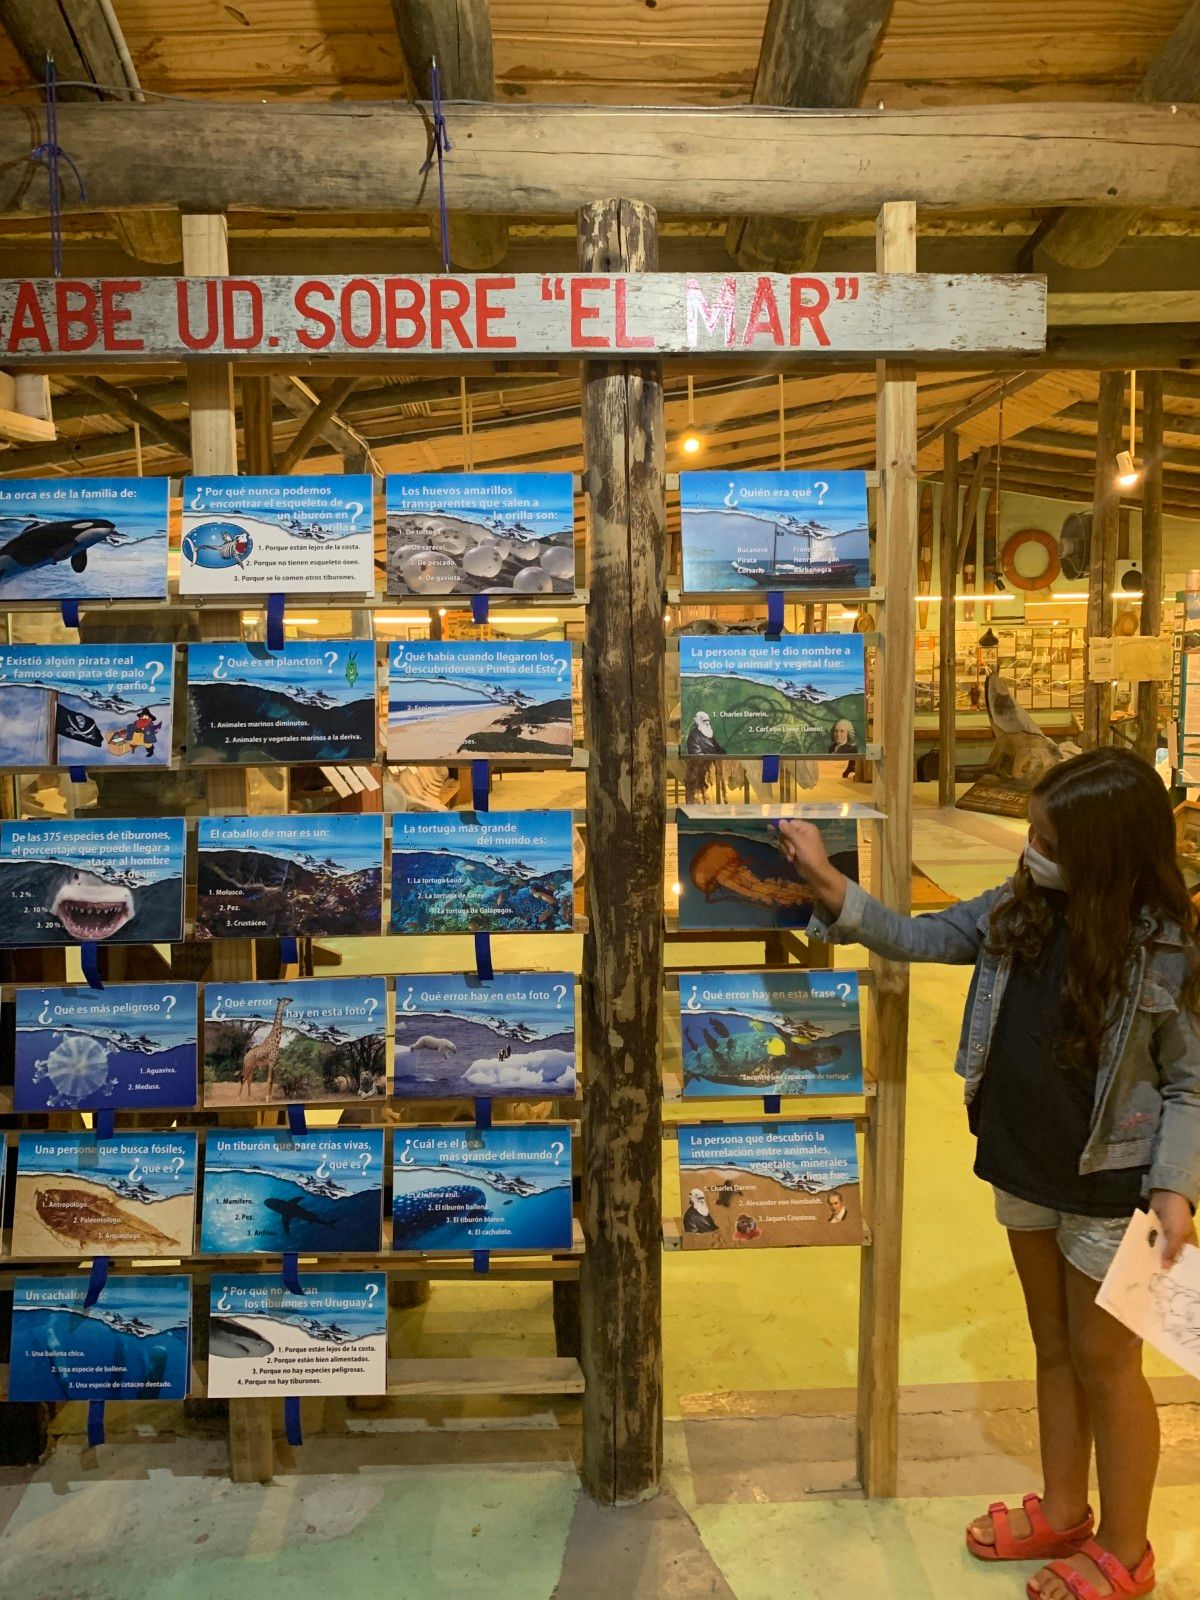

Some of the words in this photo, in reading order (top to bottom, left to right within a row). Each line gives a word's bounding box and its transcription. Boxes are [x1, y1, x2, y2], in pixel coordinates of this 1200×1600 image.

[176, 280, 280, 350] UD.
[294, 278, 517, 349] SOBRE
[0, 490, 11, 499] La
[54, 490, 66, 499] de
[70, 490, 78, 498] la
[81, 489, 117, 498] familia
[226, 487, 245, 498] qué
[282, 487, 331, 497] podemos
[402, 487, 419, 496] Los
[423, 487, 460, 495] huevos
[464, 486, 512, 495] amarillos
[210, 500, 261, 508] encontrar
[264, 499, 273, 507] el
[276, 499, 328, 510] esqueleto
[330, 498, 343, 506] de
[402, 500, 476, 509] transparentes
[480, 501, 499, 509] que
[503, 499, 529, 507] salen
[494, 511, 502, 520] la
[506, 511, 533, 519] orilla
[692, 648, 702, 656] La
[706, 648, 746, 658] persona
[749, 648, 768, 658] que
[771, 646, 780, 655] le
[784, 646, 798, 656] dio
[802, 646, 842, 655] nombre
[45, 656, 75, 667] algún
[79, 656, 110, 666] pirata
[114, 656, 133, 664] real
[265, 658, 274, 666] el
[699, 660, 722, 669] todo
[726, 660, 734, 668] lo
[738, 660, 772, 668] animal
[775, 661, 780, 670] y
[784, 660, 821, 670] vegetal
[405, 665, 475, 673] descubridores
[487, 665, 516, 673] Punta
[519, 664, 533, 673] del
[14, 669, 53, 678] famoso
[78, 669, 102, 679] pata
[105, 669, 118, 677] de
[121, 669, 144, 678] palo
[108, 684, 114, 692] y
[211, 830, 219, 838] El
[222, 829, 258, 838] caballo
[262, 829, 274, 837] de
[404, 825, 415, 833] La
[418, 825, 455, 834] tortuga
[459, 824, 478, 832] más
[482, 824, 516, 834] grande
[12, 833, 25, 842] De
[28, 833, 40, 841] las
[43, 832, 60, 842] 375
[63, 832, 104, 841] especies
[107, 832, 118, 840] de
[471, 992, 488, 1002] hay
[77, 1006, 87, 1014] es
[91, 1003, 110, 1013] más
[286, 1009, 303, 1019] hay
[322, 1008, 342, 1016] esta
[691, 1136, 702, 1145] La
[705, 1136, 743, 1146] persona
[746, 1136, 763, 1145] que
[766, 1132, 812, 1142] descubrió
[816, 1132, 824, 1141] la
[35, 1145, 54, 1154] Una
[100, 1146, 117, 1156] que
[121, 1145, 148, 1154] busca
[218, 1142, 231, 1150] Un
[234, 1141, 269, 1150] tiburón
[273, 1143, 291, 1152] que
[294, 1143, 316, 1151] pare
[319, 1141, 341, 1149] crías
[440, 1151, 460, 1160] más
[463, 1151, 496, 1162] grande
[500, 1151, 515, 1159] del
